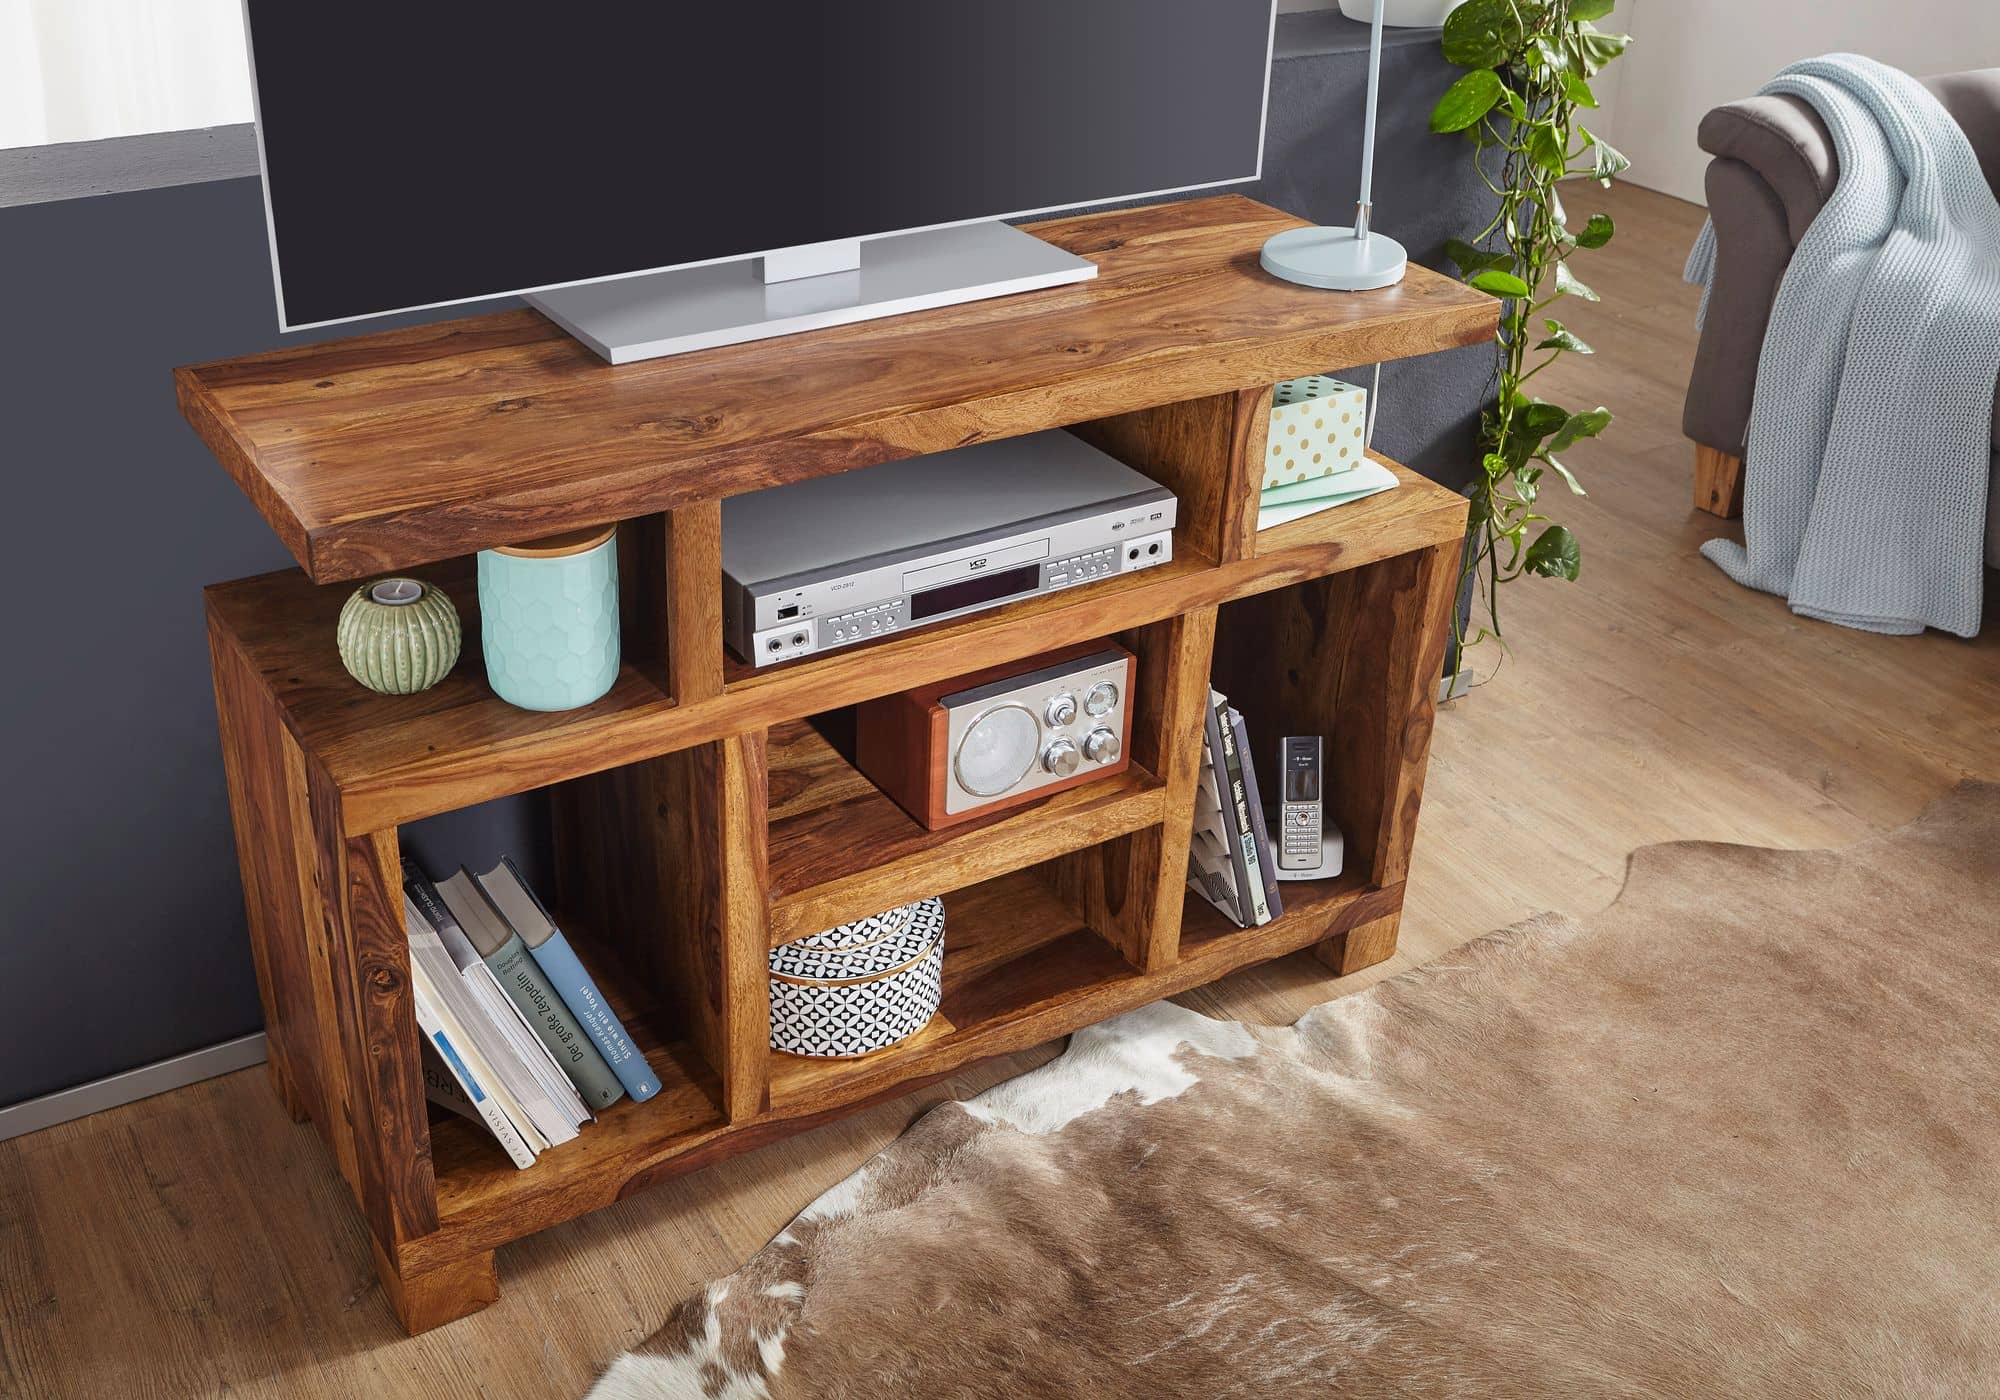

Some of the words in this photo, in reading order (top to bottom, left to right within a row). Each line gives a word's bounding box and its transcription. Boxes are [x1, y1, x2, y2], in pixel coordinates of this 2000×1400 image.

[970, 559, 987, 568] VCD
[497, 951, 519, 970] Douglas
[515, 970, 552, 1016] Zeppelin
[579, 986, 597, 1010] Vogel
[546, 1010, 574, 1045] große
[584, 1009, 604, 1036] Kanger
[596, 1010, 609, 1025] ein
[606, 1024, 620, 1040] wie
[563, 1041, 583, 1062] Der
[601, 1036, 622, 1064] Thomas
[615, 1038, 632, 1059] Sing
[487, 1109, 513, 1145] VISTAS
